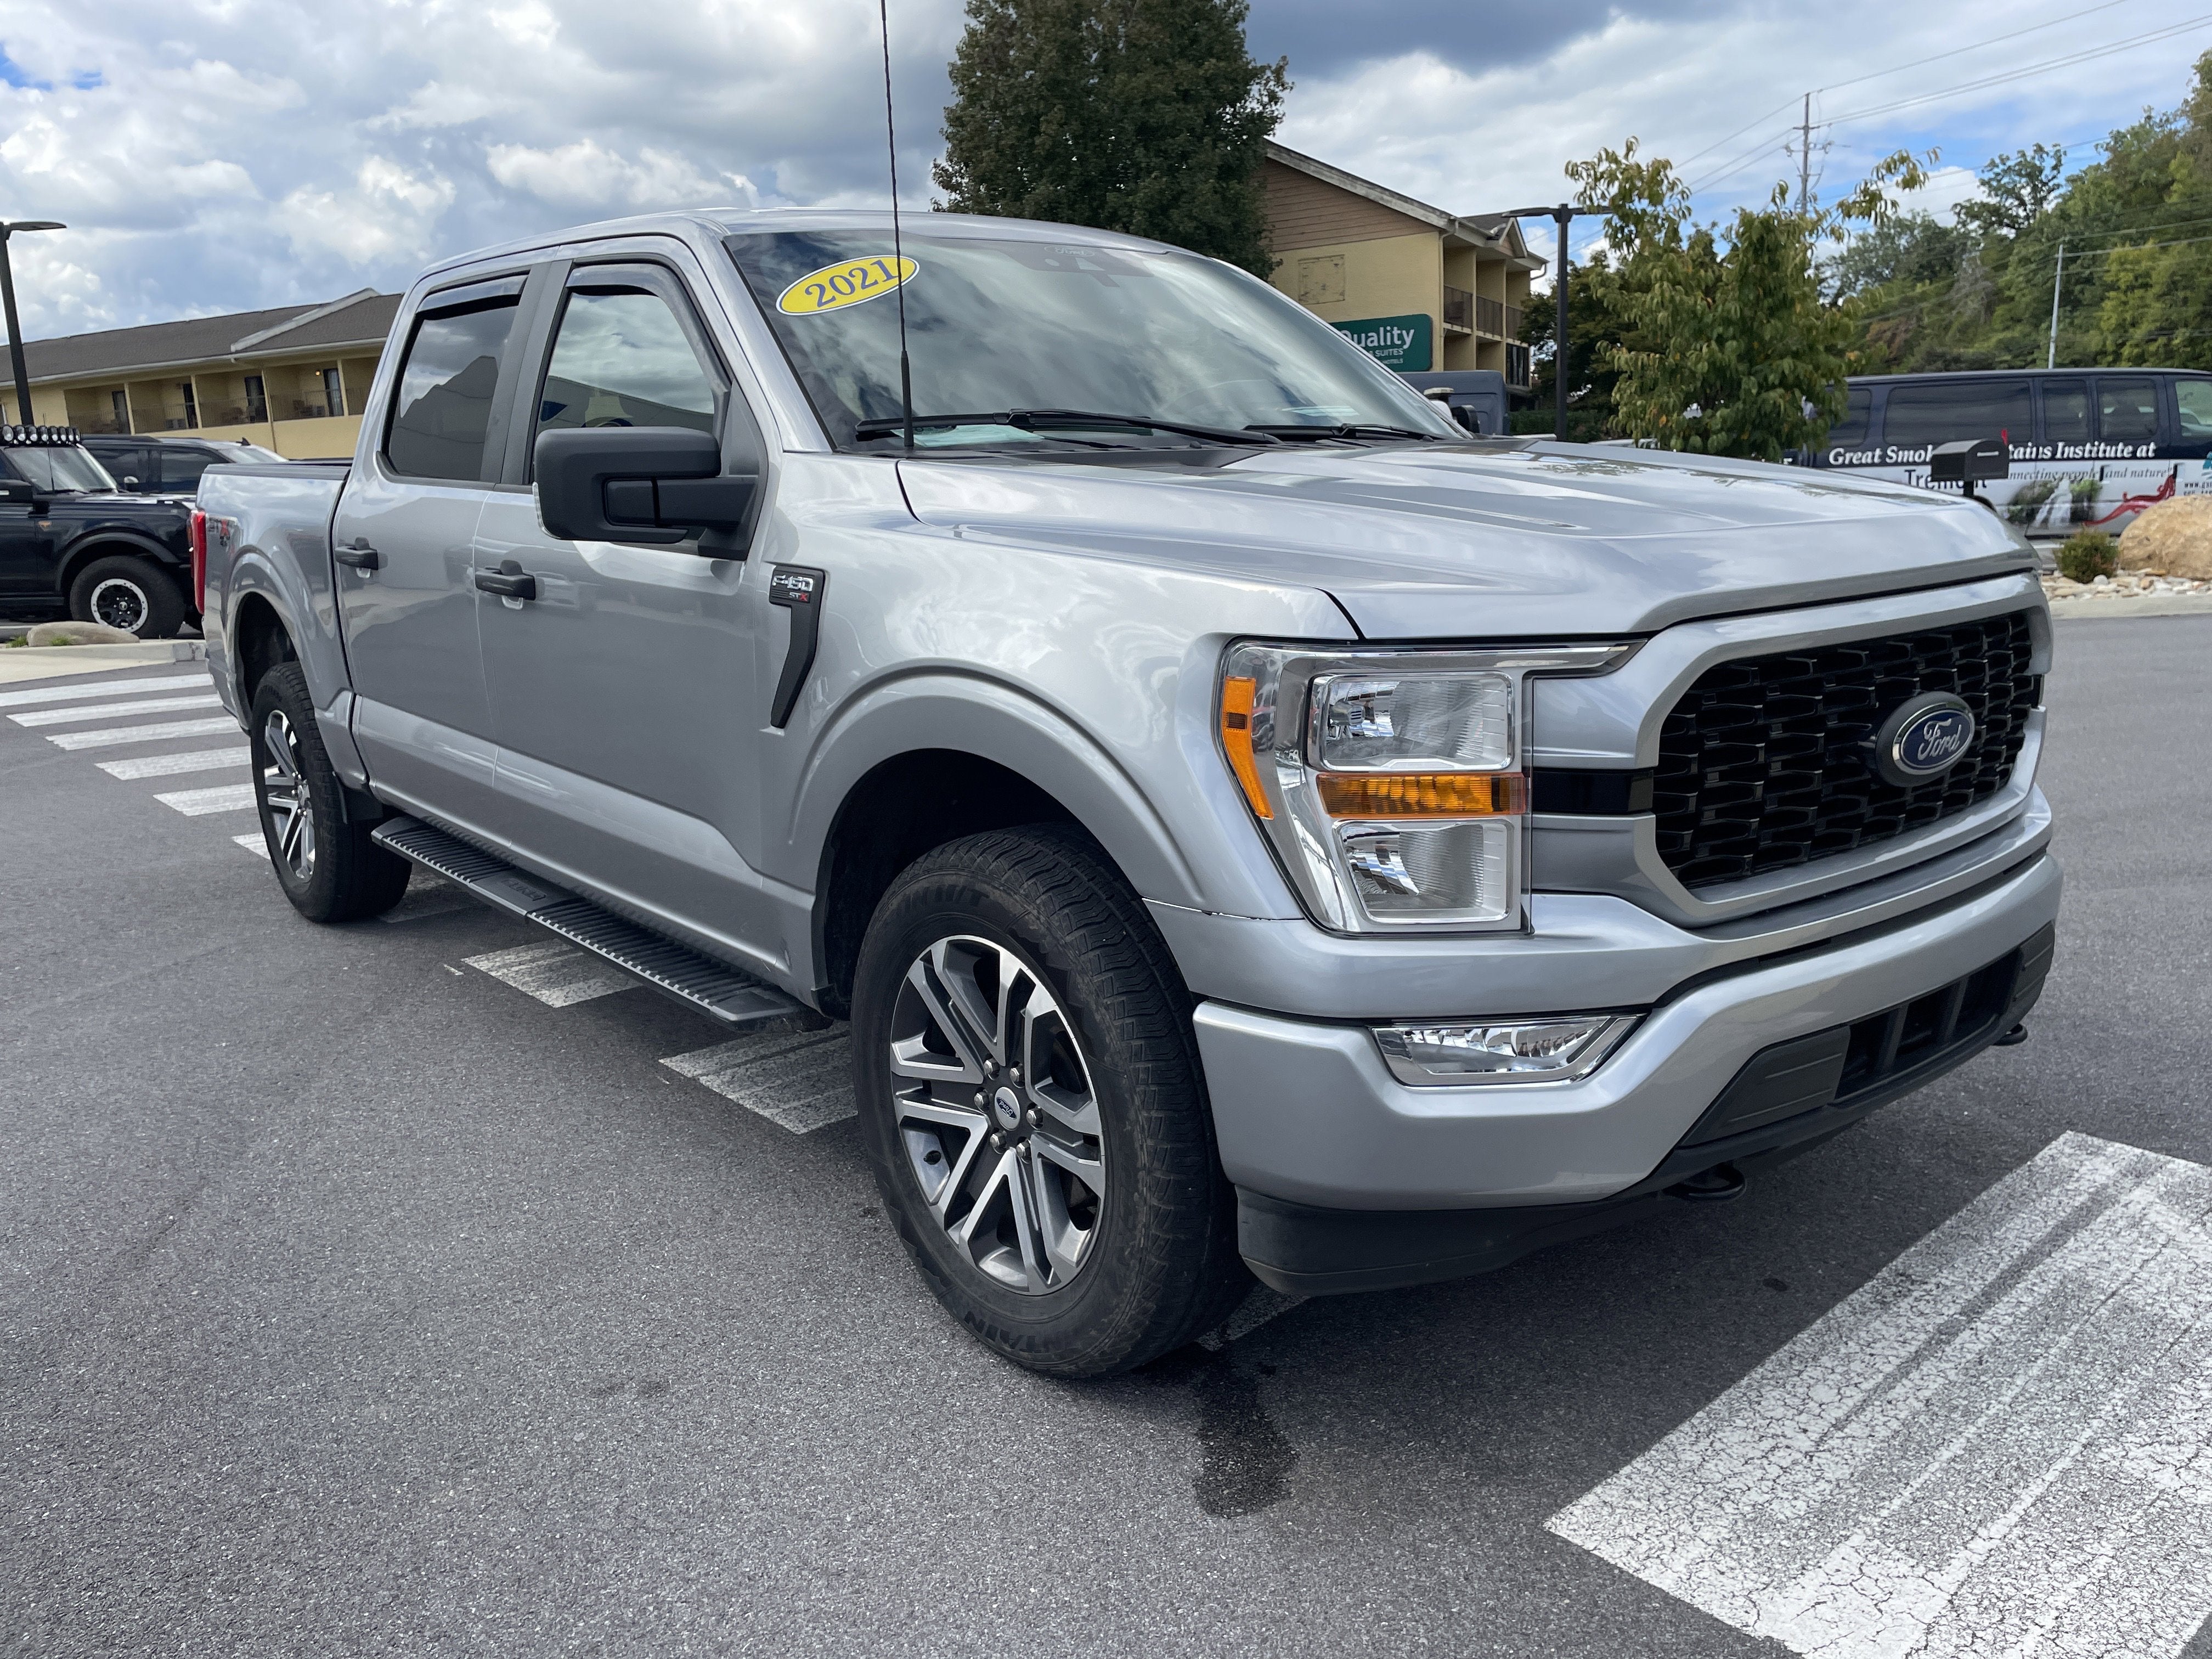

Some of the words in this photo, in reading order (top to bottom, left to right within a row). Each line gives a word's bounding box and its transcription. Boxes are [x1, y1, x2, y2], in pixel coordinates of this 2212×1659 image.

[805, 259, 899, 307] 2021
[1375, 348, 1404, 357] SUITES
[1829, 447, 1882, 465] Great
[2008, 441, 2053, 460] tains
[2055, 441, 2133, 459] Institute
[2136, 441, 2157, 459] at
[2009, 469, 2058, 482] nnecting
[772, 574, 814, 592] F-150
[788, 591, 808, 602] STX
[1917, 718, 1962, 760] Ford
